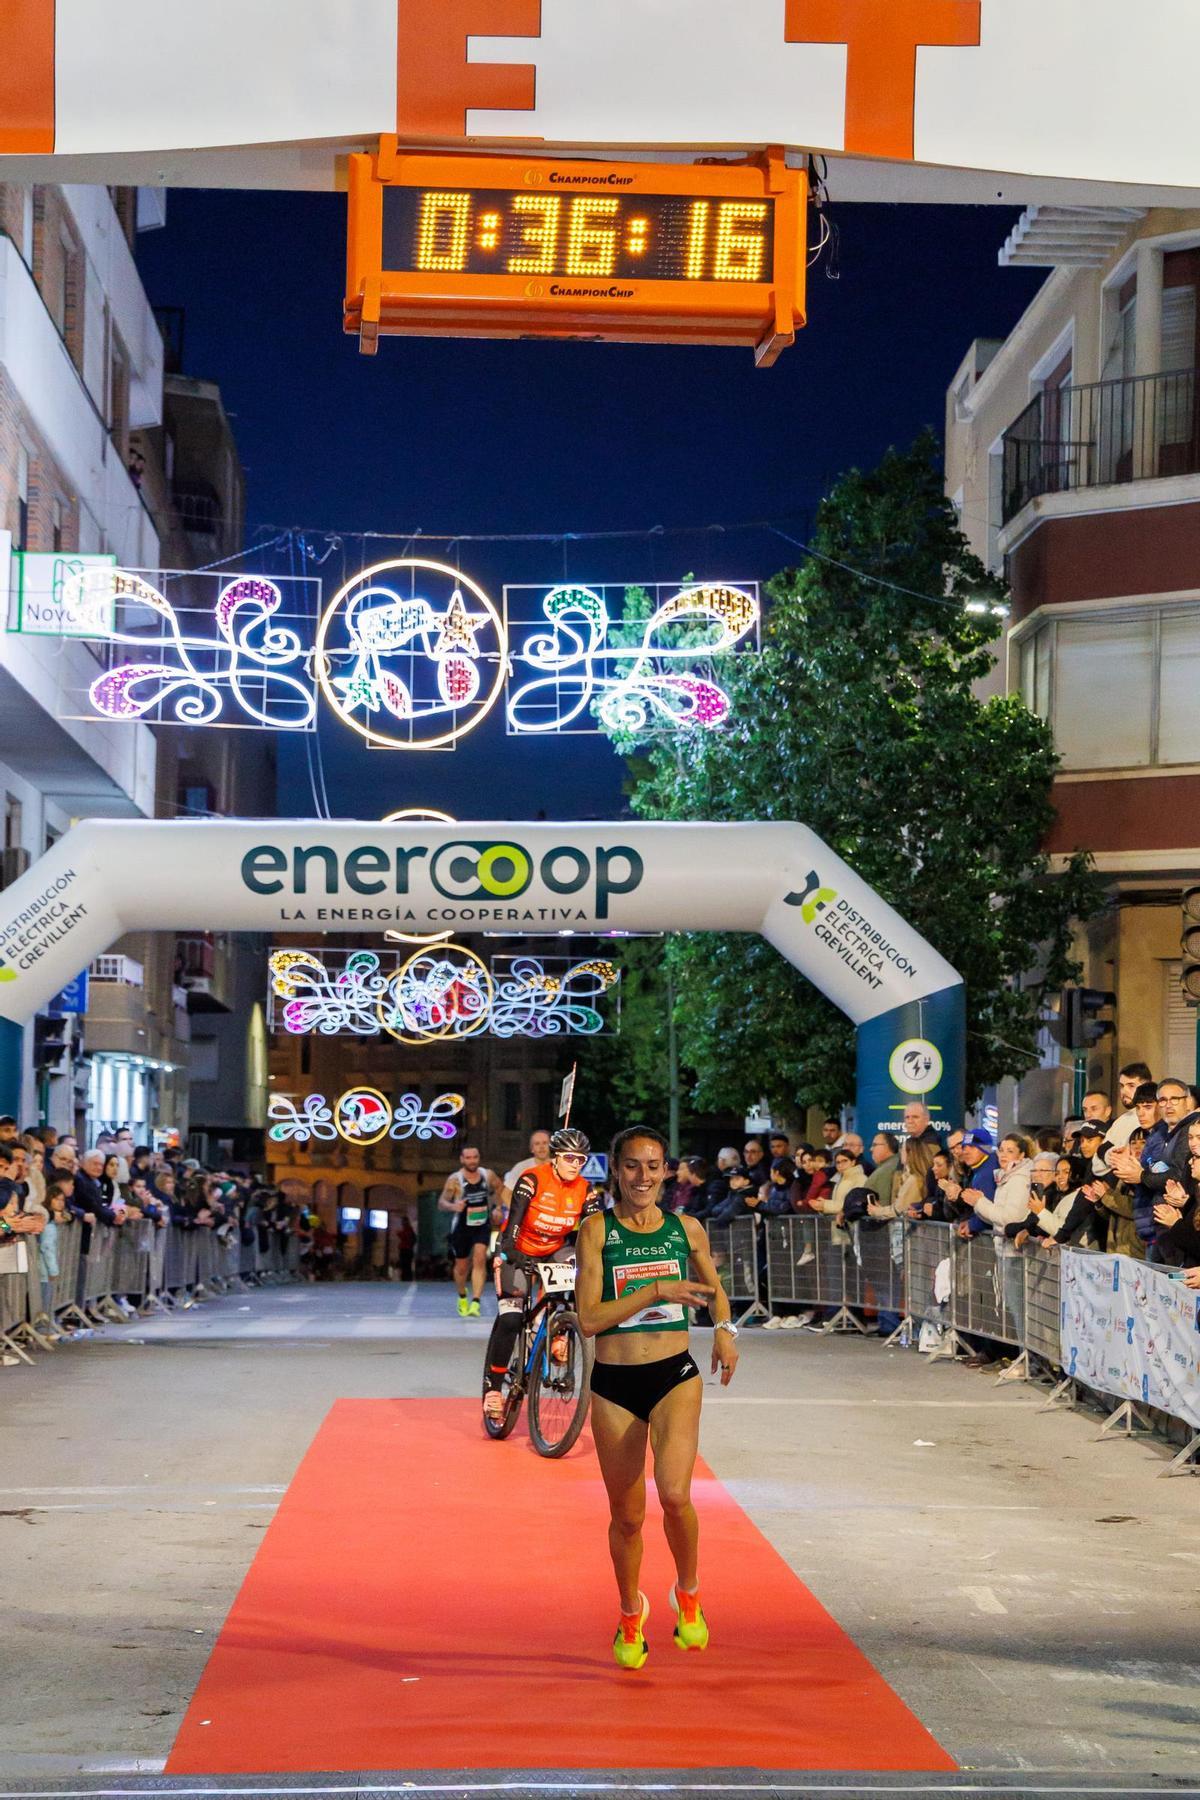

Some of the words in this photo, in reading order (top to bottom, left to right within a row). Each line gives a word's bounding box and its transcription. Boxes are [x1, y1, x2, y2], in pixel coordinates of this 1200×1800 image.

[416, 192, 767, 281] 0:36:16
[241, 842, 643, 919] enercoop
[280, 908, 306, 920] LA
[318, 905, 417, 921] ENERGÍA
[427, 908, 588, 921] COOPERATIVA
[6, 902, 70, 959] ELÉCTRICA
[19, 903, 88, 970] CREVILLENT
[814, 924, 883, 989] CREVILLENT
[825, 911, 884, 972] ELÉCTRICA
[836, 899, 918, 978] DISTRIBUCIÓN
